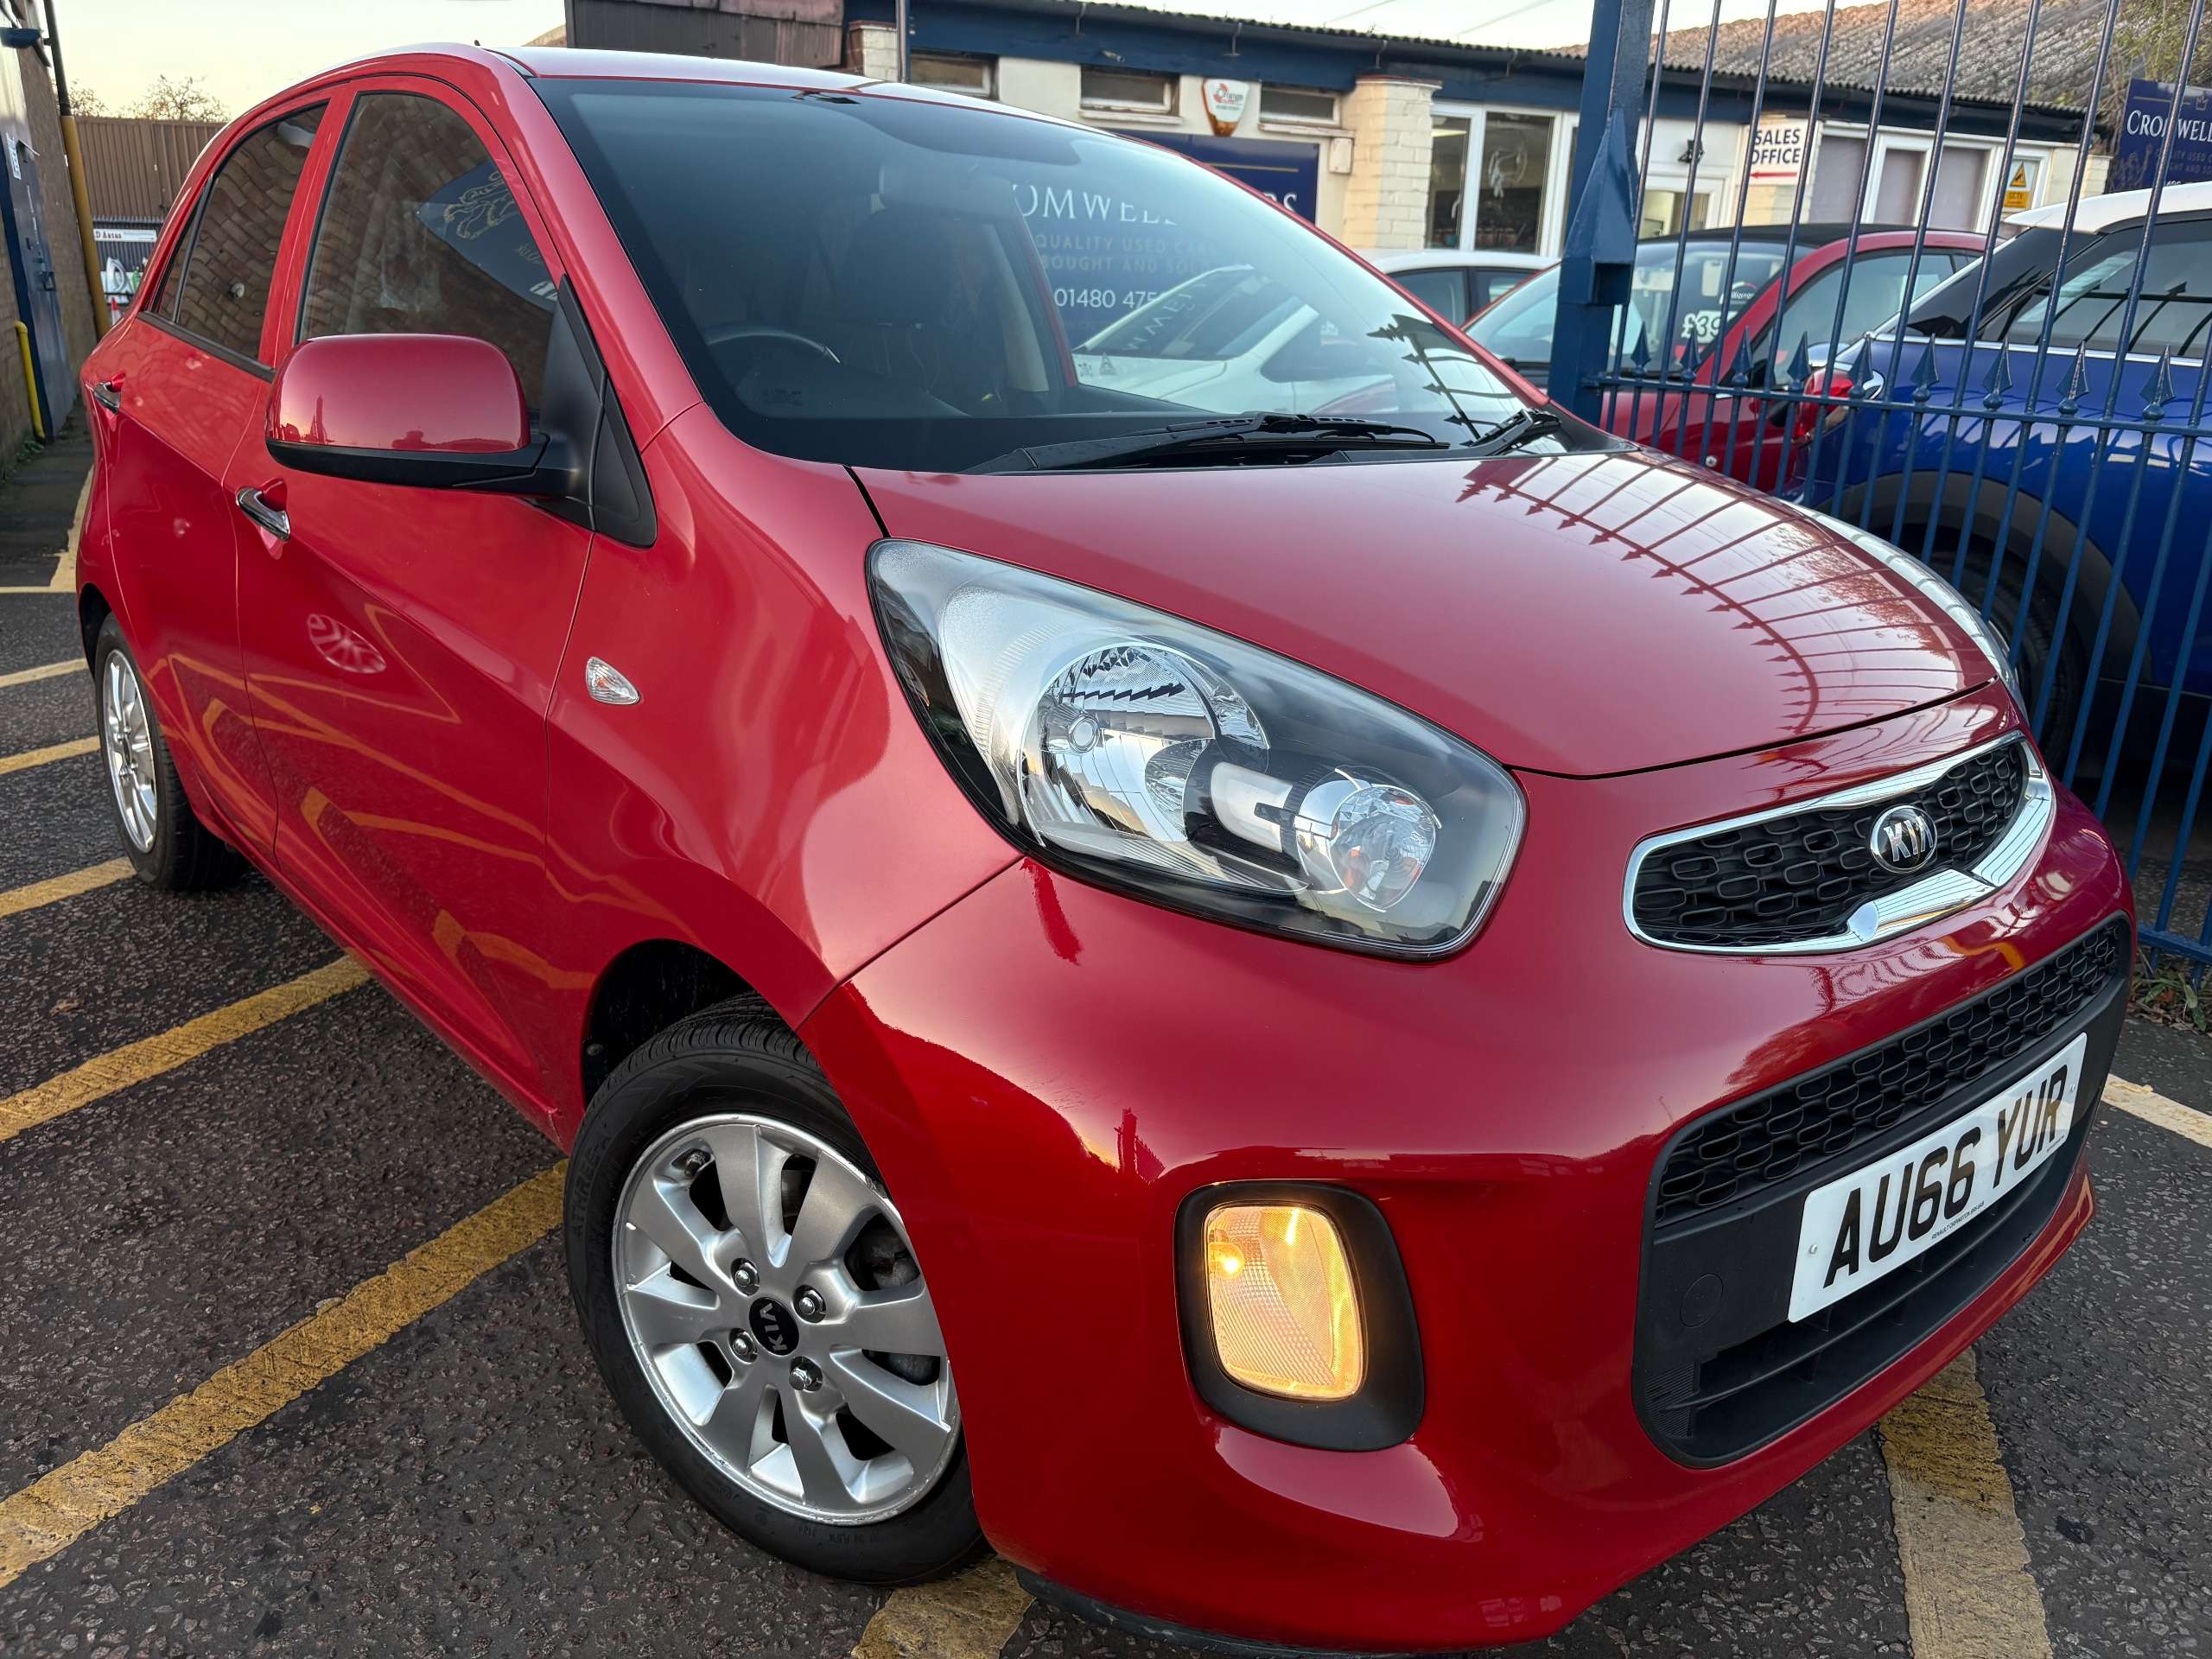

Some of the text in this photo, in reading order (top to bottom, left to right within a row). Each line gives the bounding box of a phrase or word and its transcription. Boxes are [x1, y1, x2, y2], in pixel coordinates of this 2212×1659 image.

[1755, 129, 1801, 145] SALES
[1751, 148, 1801, 164] OFFICE
[1036, 234, 1113, 249] QUALITY
[1122, 237, 1166, 254] USED
[1122, 257, 1157, 273] AND
[1054, 289, 1116, 308] 01480
[1884, 815, 1934, 862] KIA
[1823, 1064, 2068, 1288] AU66 YUR
[760, 1303, 788, 1351] KIA
